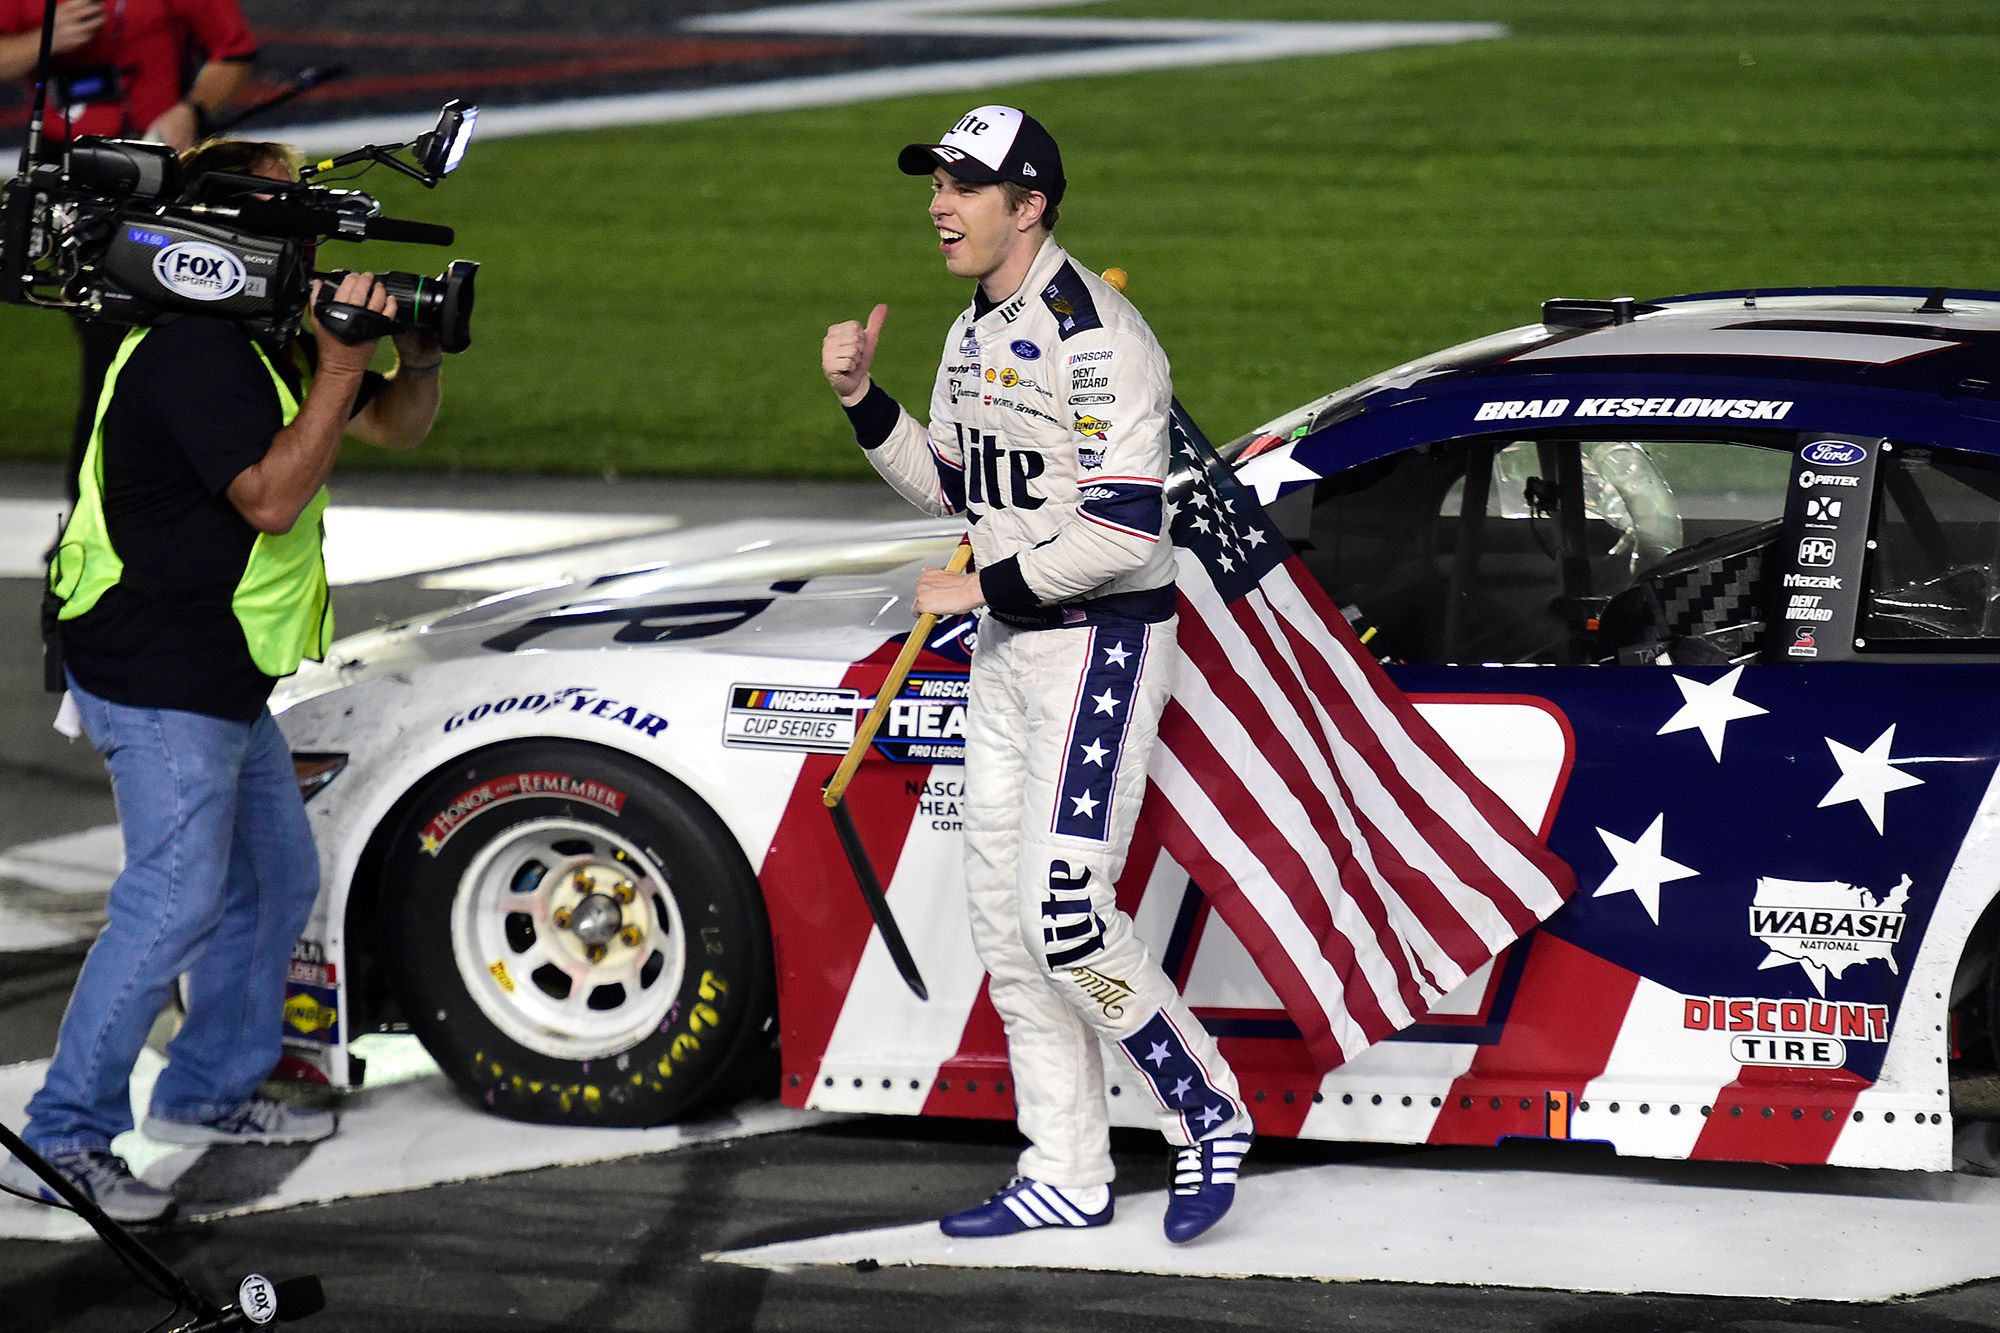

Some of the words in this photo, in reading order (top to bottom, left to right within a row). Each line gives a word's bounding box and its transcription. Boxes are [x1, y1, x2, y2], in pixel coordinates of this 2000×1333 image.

[175, 253, 224, 280] FOX
[243, 254, 274, 266] SONY
[173, 273, 223, 290] SPORTS
[998, 296, 1027, 324] Lite
[1074, 350, 1114, 364] NASCAR
[1072, 366, 1096, 379] DENT
[1072, 377, 1108, 390] WIZARD
[1015, 403, 1058, 423] Snap-on
[1474, 400, 1570, 420] BRAD
[1574, 398, 1794, 420] KESELOWSKI
[1073, 421, 1108, 431] SUNOCO
[1810, 443, 1856, 463] Ford
[1814, 474, 1860, 487] PIRTEK
[1800, 540, 1834, 563] PPG
[1783, 574, 1842, 589] Mazak
[1788, 594, 1822, 608] DENT
[1785, 607, 1833, 621] WIZARD
[920, 680, 971, 699] NASCA
[768, 690, 841, 713] NASCAR
[443, 687, 669, 738] GOODYEAR
[888, 705, 967, 739] HEA
[743, 717, 778, 734] CUP
[779, 719, 837, 738] SERIES
[907, 745, 930, 758] PRO
[930, 745, 966, 759] LEAGU
[905, 780, 965, 798] NASC
[433, 786, 497, 831] HONOR
[518, 774, 619, 808] REMEMBER
[920, 801, 965, 816] HEA
[1041, 860, 1107, 972] Lite
[1753, 910, 1902, 940] WABASH
[1800, 940, 1860, 952] NATIONAL
[1684, 998, 1888, 1040] DISCOUNT
[1741, 1039, 1831, 1062] TIRE
[251, 1284, 271, 1312] FOX
